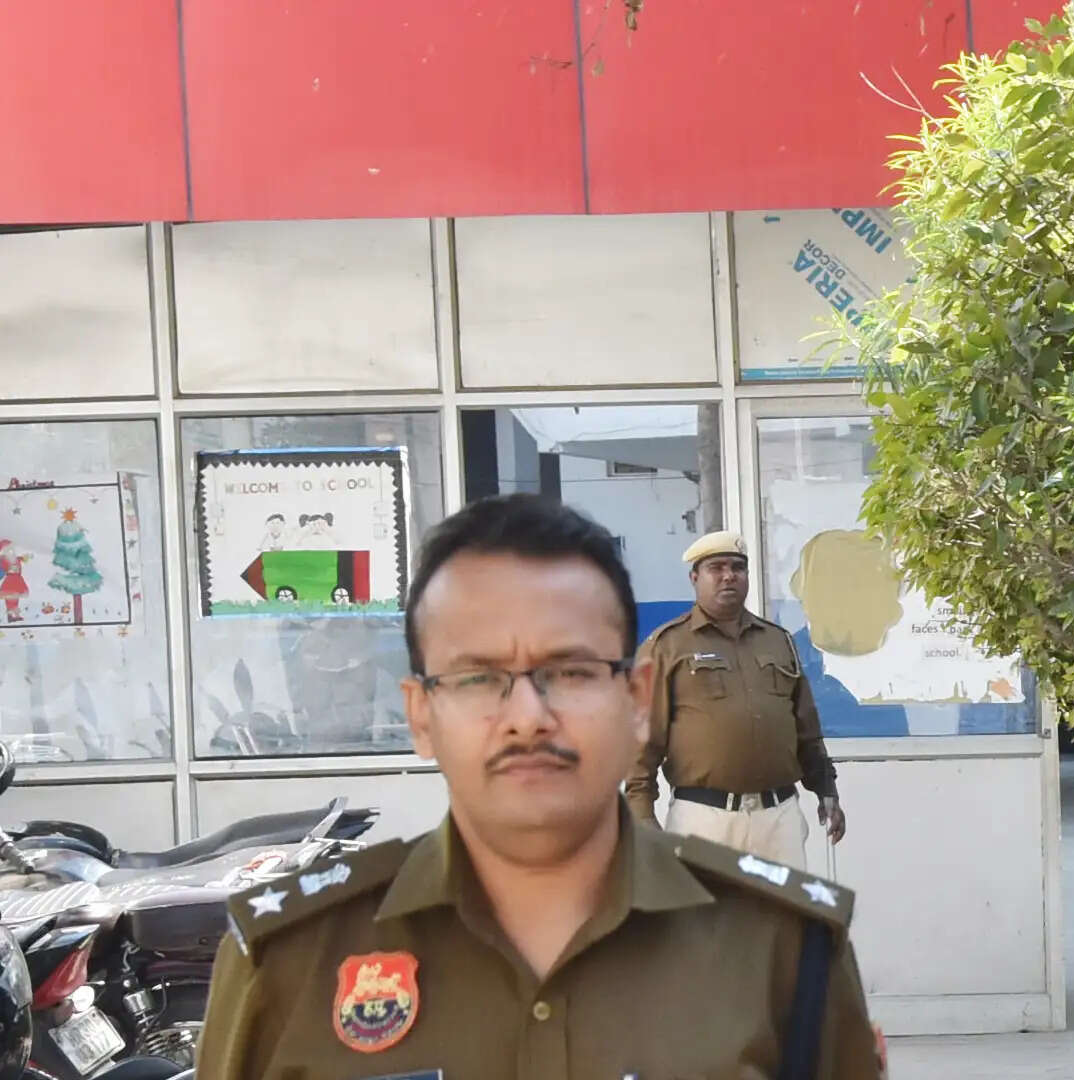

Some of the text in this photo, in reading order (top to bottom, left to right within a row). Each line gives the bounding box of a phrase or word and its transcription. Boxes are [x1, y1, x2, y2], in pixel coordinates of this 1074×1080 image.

[832, 208, 892, 254] IMP
[803, 239, 846, 280] DECOR
[911, 624, 938, 634] faces
